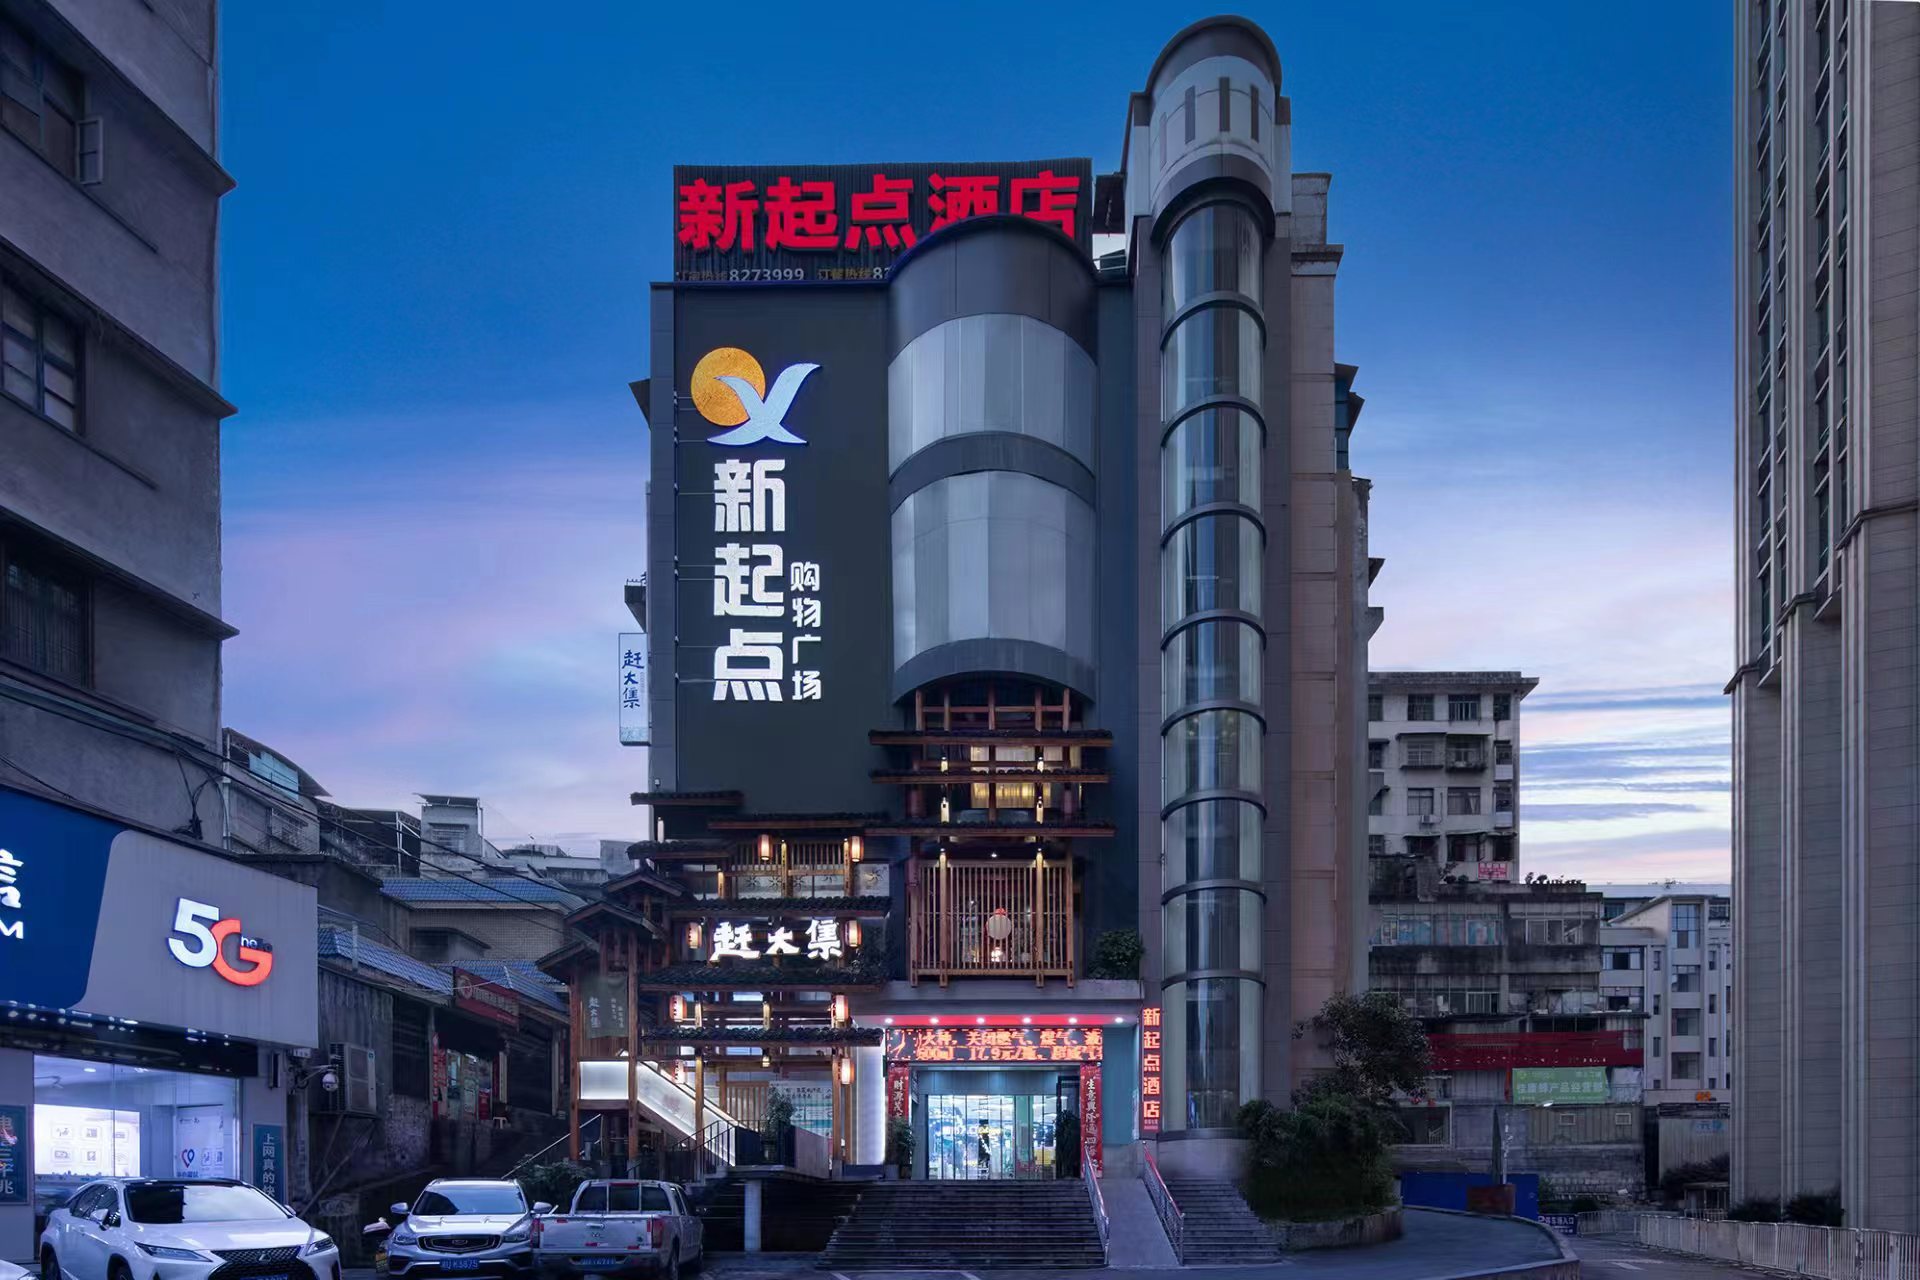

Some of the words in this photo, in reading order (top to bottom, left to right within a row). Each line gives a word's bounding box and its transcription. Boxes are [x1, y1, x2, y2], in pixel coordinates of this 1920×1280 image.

[713, 459, 786, 702] 新起点
[621, 649, 645, 709] 赶大集
[790, 562, 821, 700] 购物广场
[168, 898, 273, 986] 5G
[709, 919, 843, 961] 赶大集
[1143, 1007, 1161, 1119] 新起点酒店
